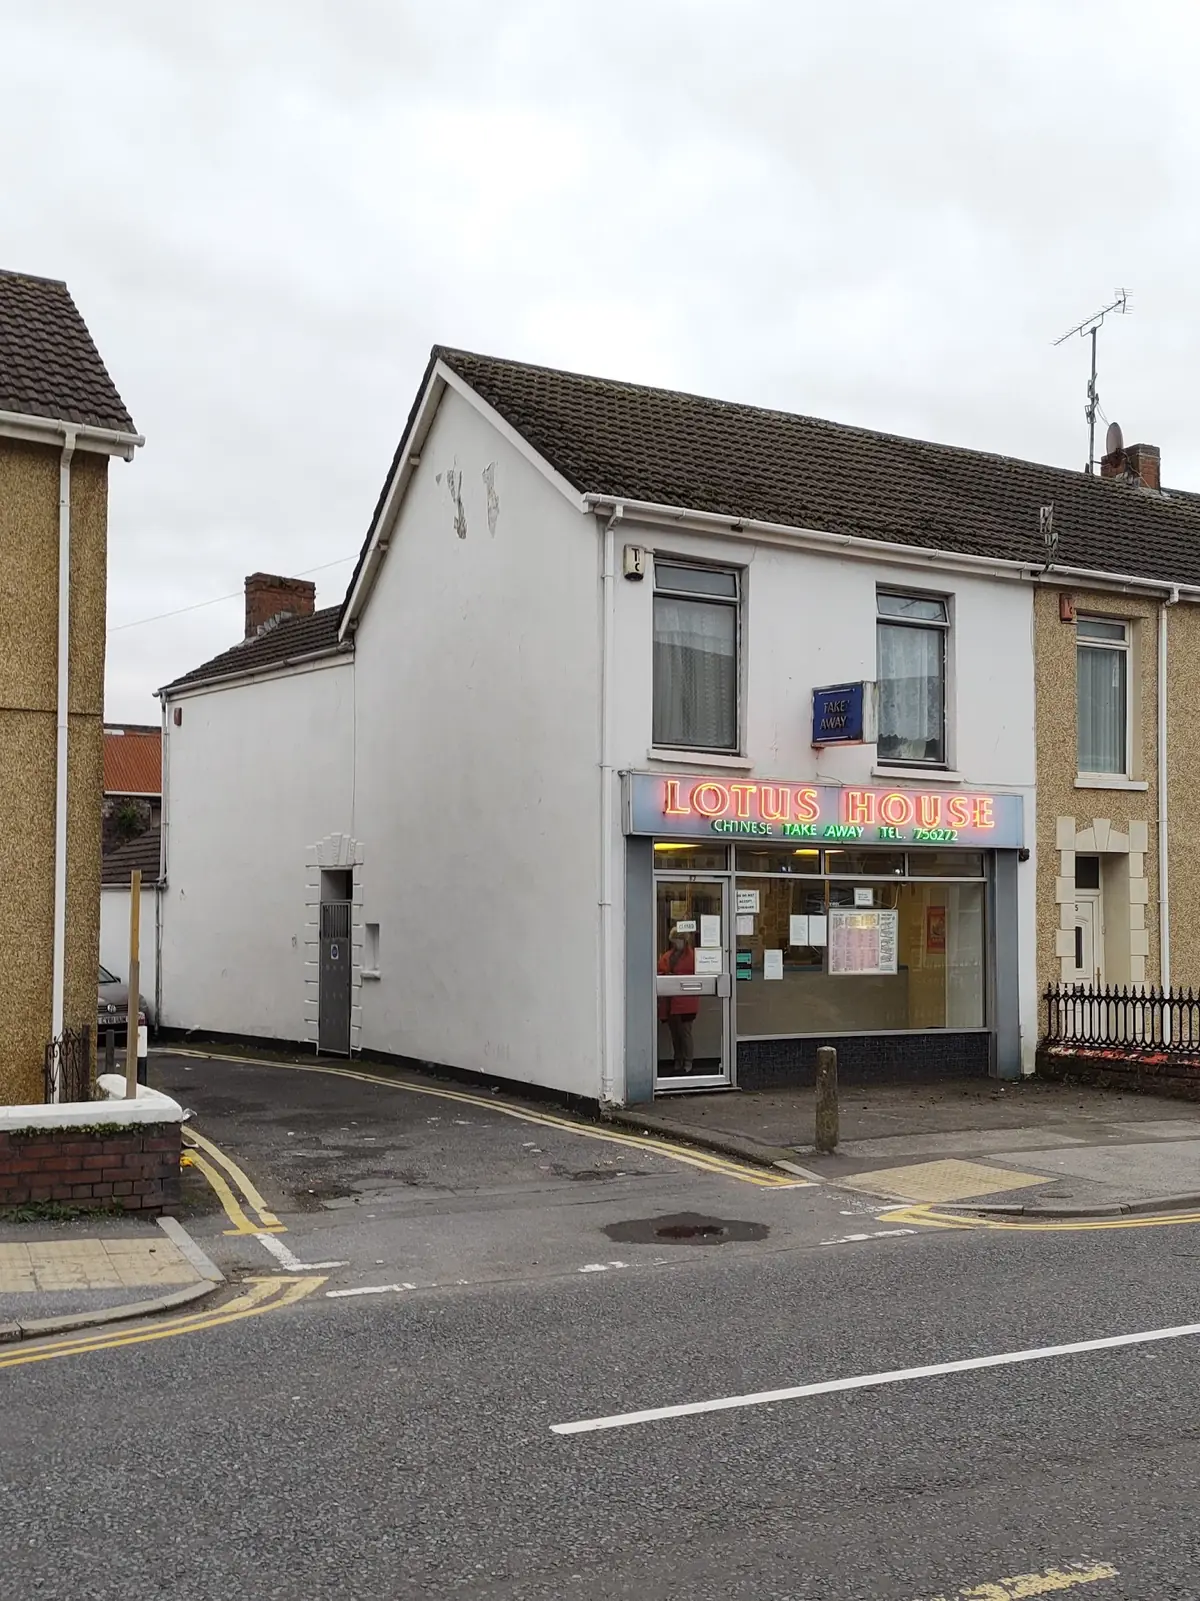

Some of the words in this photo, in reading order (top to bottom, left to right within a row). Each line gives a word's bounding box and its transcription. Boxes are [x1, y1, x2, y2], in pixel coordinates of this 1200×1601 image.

[823, 700, 846, 714] TAKE
[820, 715, 847, 730] AWAY
[665, 780, 820, 822] LOTUS
[846, 791, 995, 828] HOUSE
[712, 819, 773, 836] CHINESE
[783, 823, 817, 837] TAKE
[825, 826, 865, 839] AWAY
[880, 826, 906, 839] TEL.
[914, 828, 959, 841] 756272
